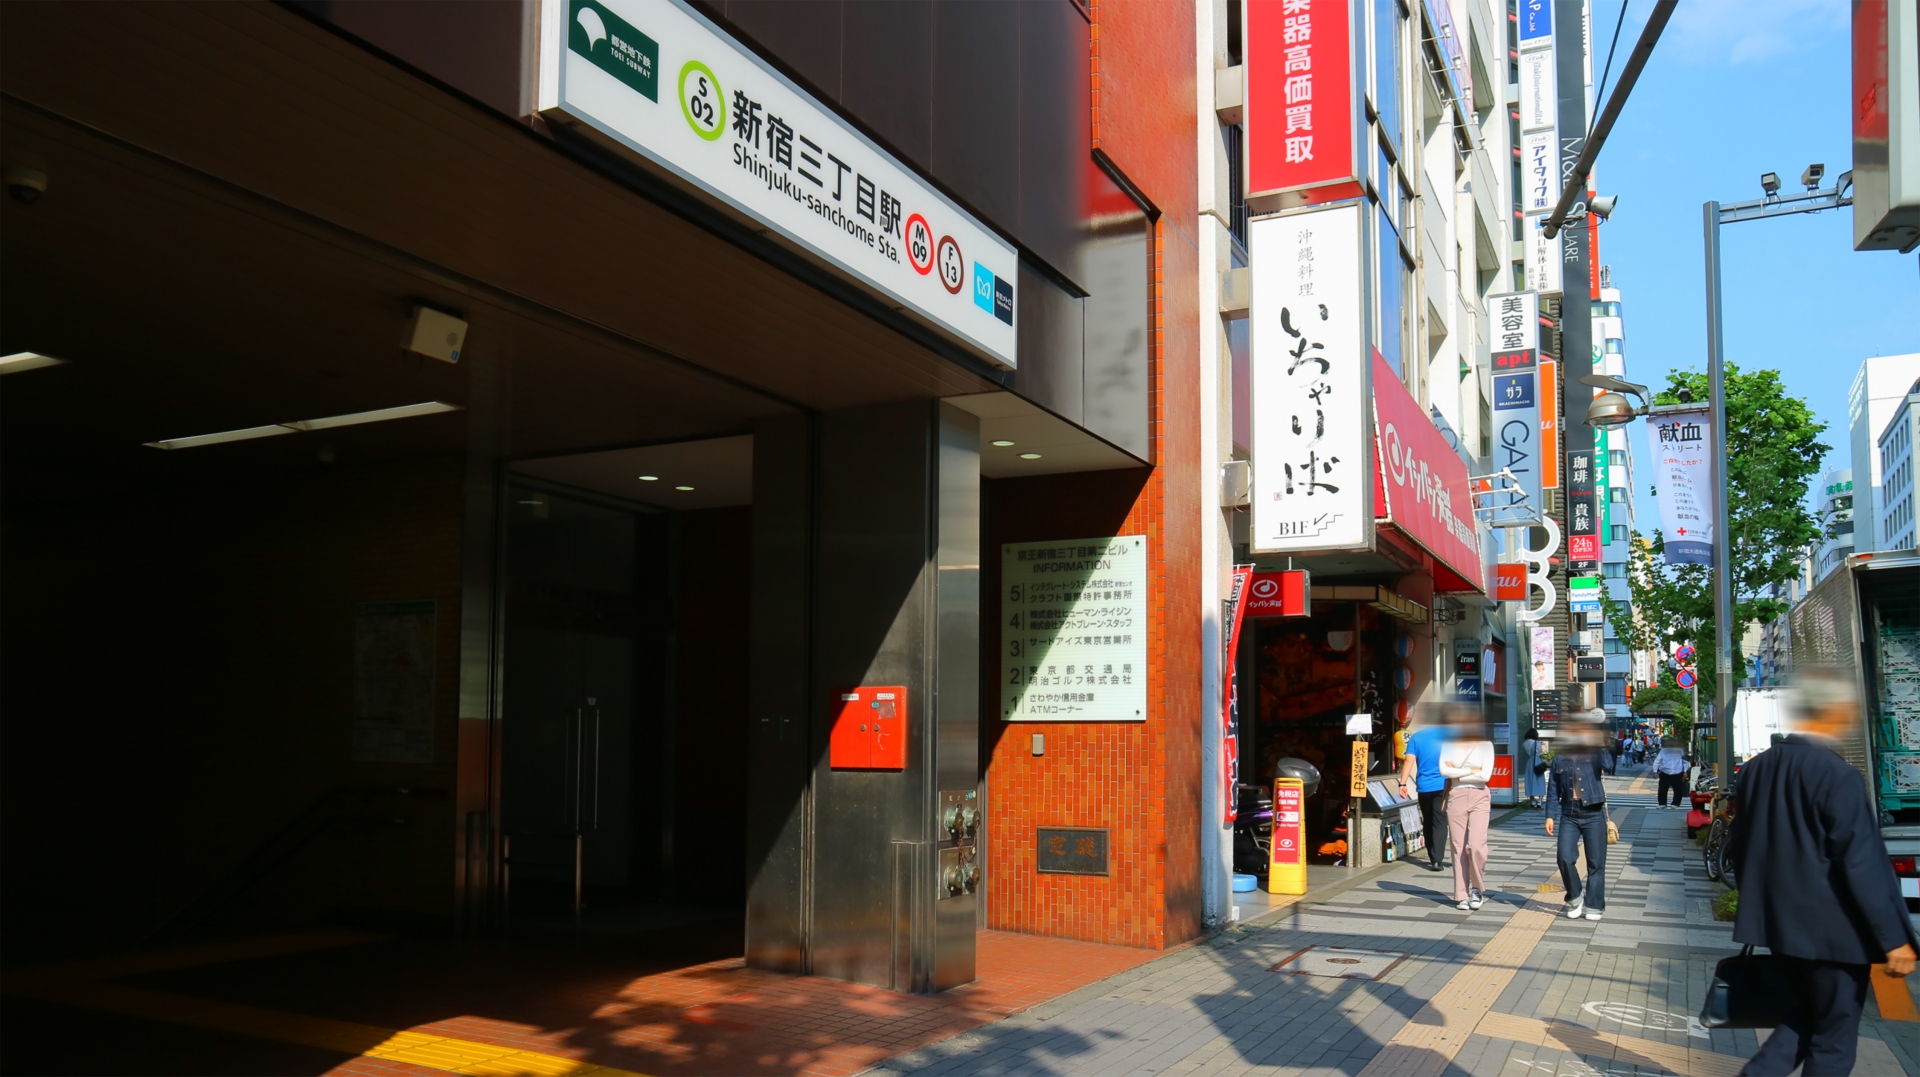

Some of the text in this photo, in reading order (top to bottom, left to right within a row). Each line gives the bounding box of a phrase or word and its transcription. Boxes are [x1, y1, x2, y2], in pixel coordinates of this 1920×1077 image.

[611, 34, 651, 68] 都営地下鉄
[611, 47, 650, 78] TOEI SUBWAY
[698, 77, 708, 98] S
[690, 96, 714, 128] 02
[732, 90, 902, 241] 新宿三丁目駅
[733, 143, 901, 265] Shinjuku-sanchome Sta.
[915, 224, 925, 243] M
[912, 241, 927, 262] 09
[949, 246, 953, 261] F
[1297, 228, 1315, 297] 沖縄料理
[945, 262, 957, 283] 13
[1502, 297, 1524, 349] 美容室
[1497, 351, 1530, 368] apt
[1281, 304, 1340, 496] いちゃりば
[1506, 386, 1522, 399] ガラ
[1541, 420, 1555, 430] u
[1658, 422, 1702, 442] 献血
[1501, 419, 1530, 511] GALA
[1572, 456, 1588, 484] 珈琲
[1574, 503, 1589, 531] 貴族
[1573, 537, 1592, 548] 24h
[1017, 545, 1128, 562] 京王新宿三丁目第二ビル
[1033, 560, 1111, 573] INFORMATION
[1010, 585, 1021, 601] 5
[1009, 613, 1020, 629] 4
[1010, 640, 1020, 656] 3
[1030, 635, 1132, 647] サードアイズ東京営業所
[1010, 668, 1020, 684] 2
[1029, 664, 1132, 675] 東京都交通局
[1029, 675, 1132, 686] 明治ゴルフ株式会社
[1011, 696, 1017, 712] 1
[1029, 693, 1095, 702] さわやか信用金庫
[1030, 705, 1083, 714] ATMコーナー
